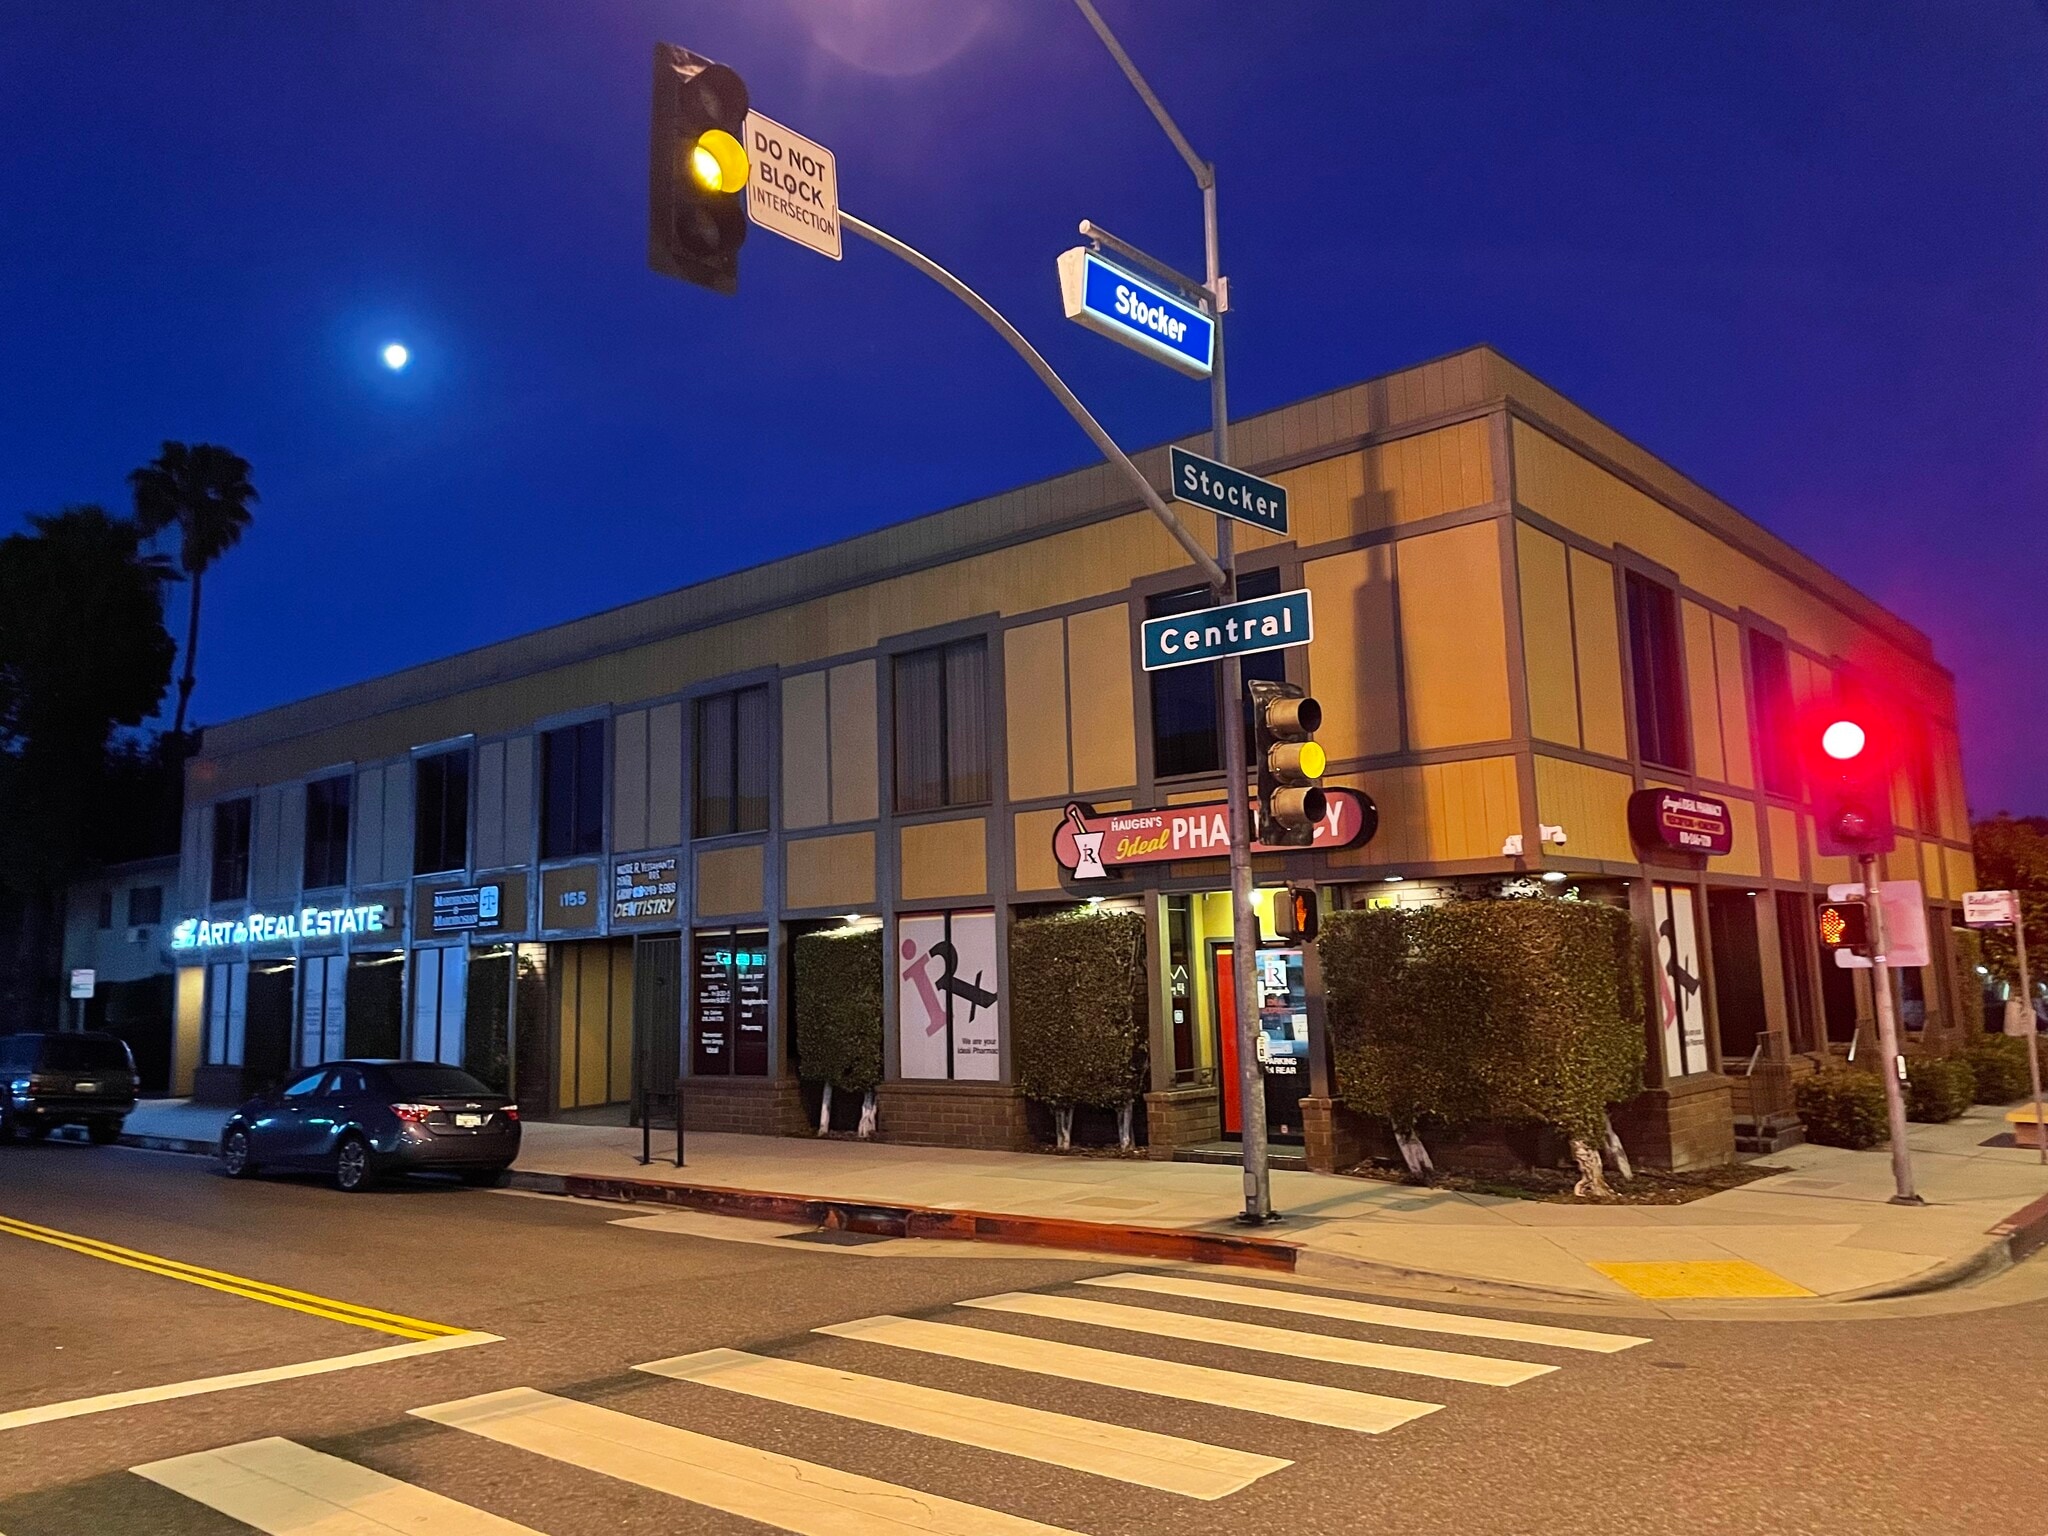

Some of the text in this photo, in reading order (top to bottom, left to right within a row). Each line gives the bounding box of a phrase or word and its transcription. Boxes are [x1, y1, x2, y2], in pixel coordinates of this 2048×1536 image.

[755, 131, 826, 182] DO NOT
[760, 161, 825, 209] BLOCK
[753, 185, 835, 236] INTERSECTION
[1114, 284, 1187, 343] Stocker
[1183, 463, 1279, 519] Stocker
[1160, 607, 1292, 655] Central
[1111, 816, 1163, 832] HAUGEN'S
[1115, 829, 1170, 860] Ideal
[1172, 801, 1343, 851] PHAY
[196, 920, 234, 946] ART
[249, 913, 300, 942] REAL
[302, 904, 384, 938] ESTATE
[614, 899, 676, 918] DENTISTRY
[1265, 1057, 1297, 1066] PARKING
[1275, 1066, 1297, 1074] REAR
